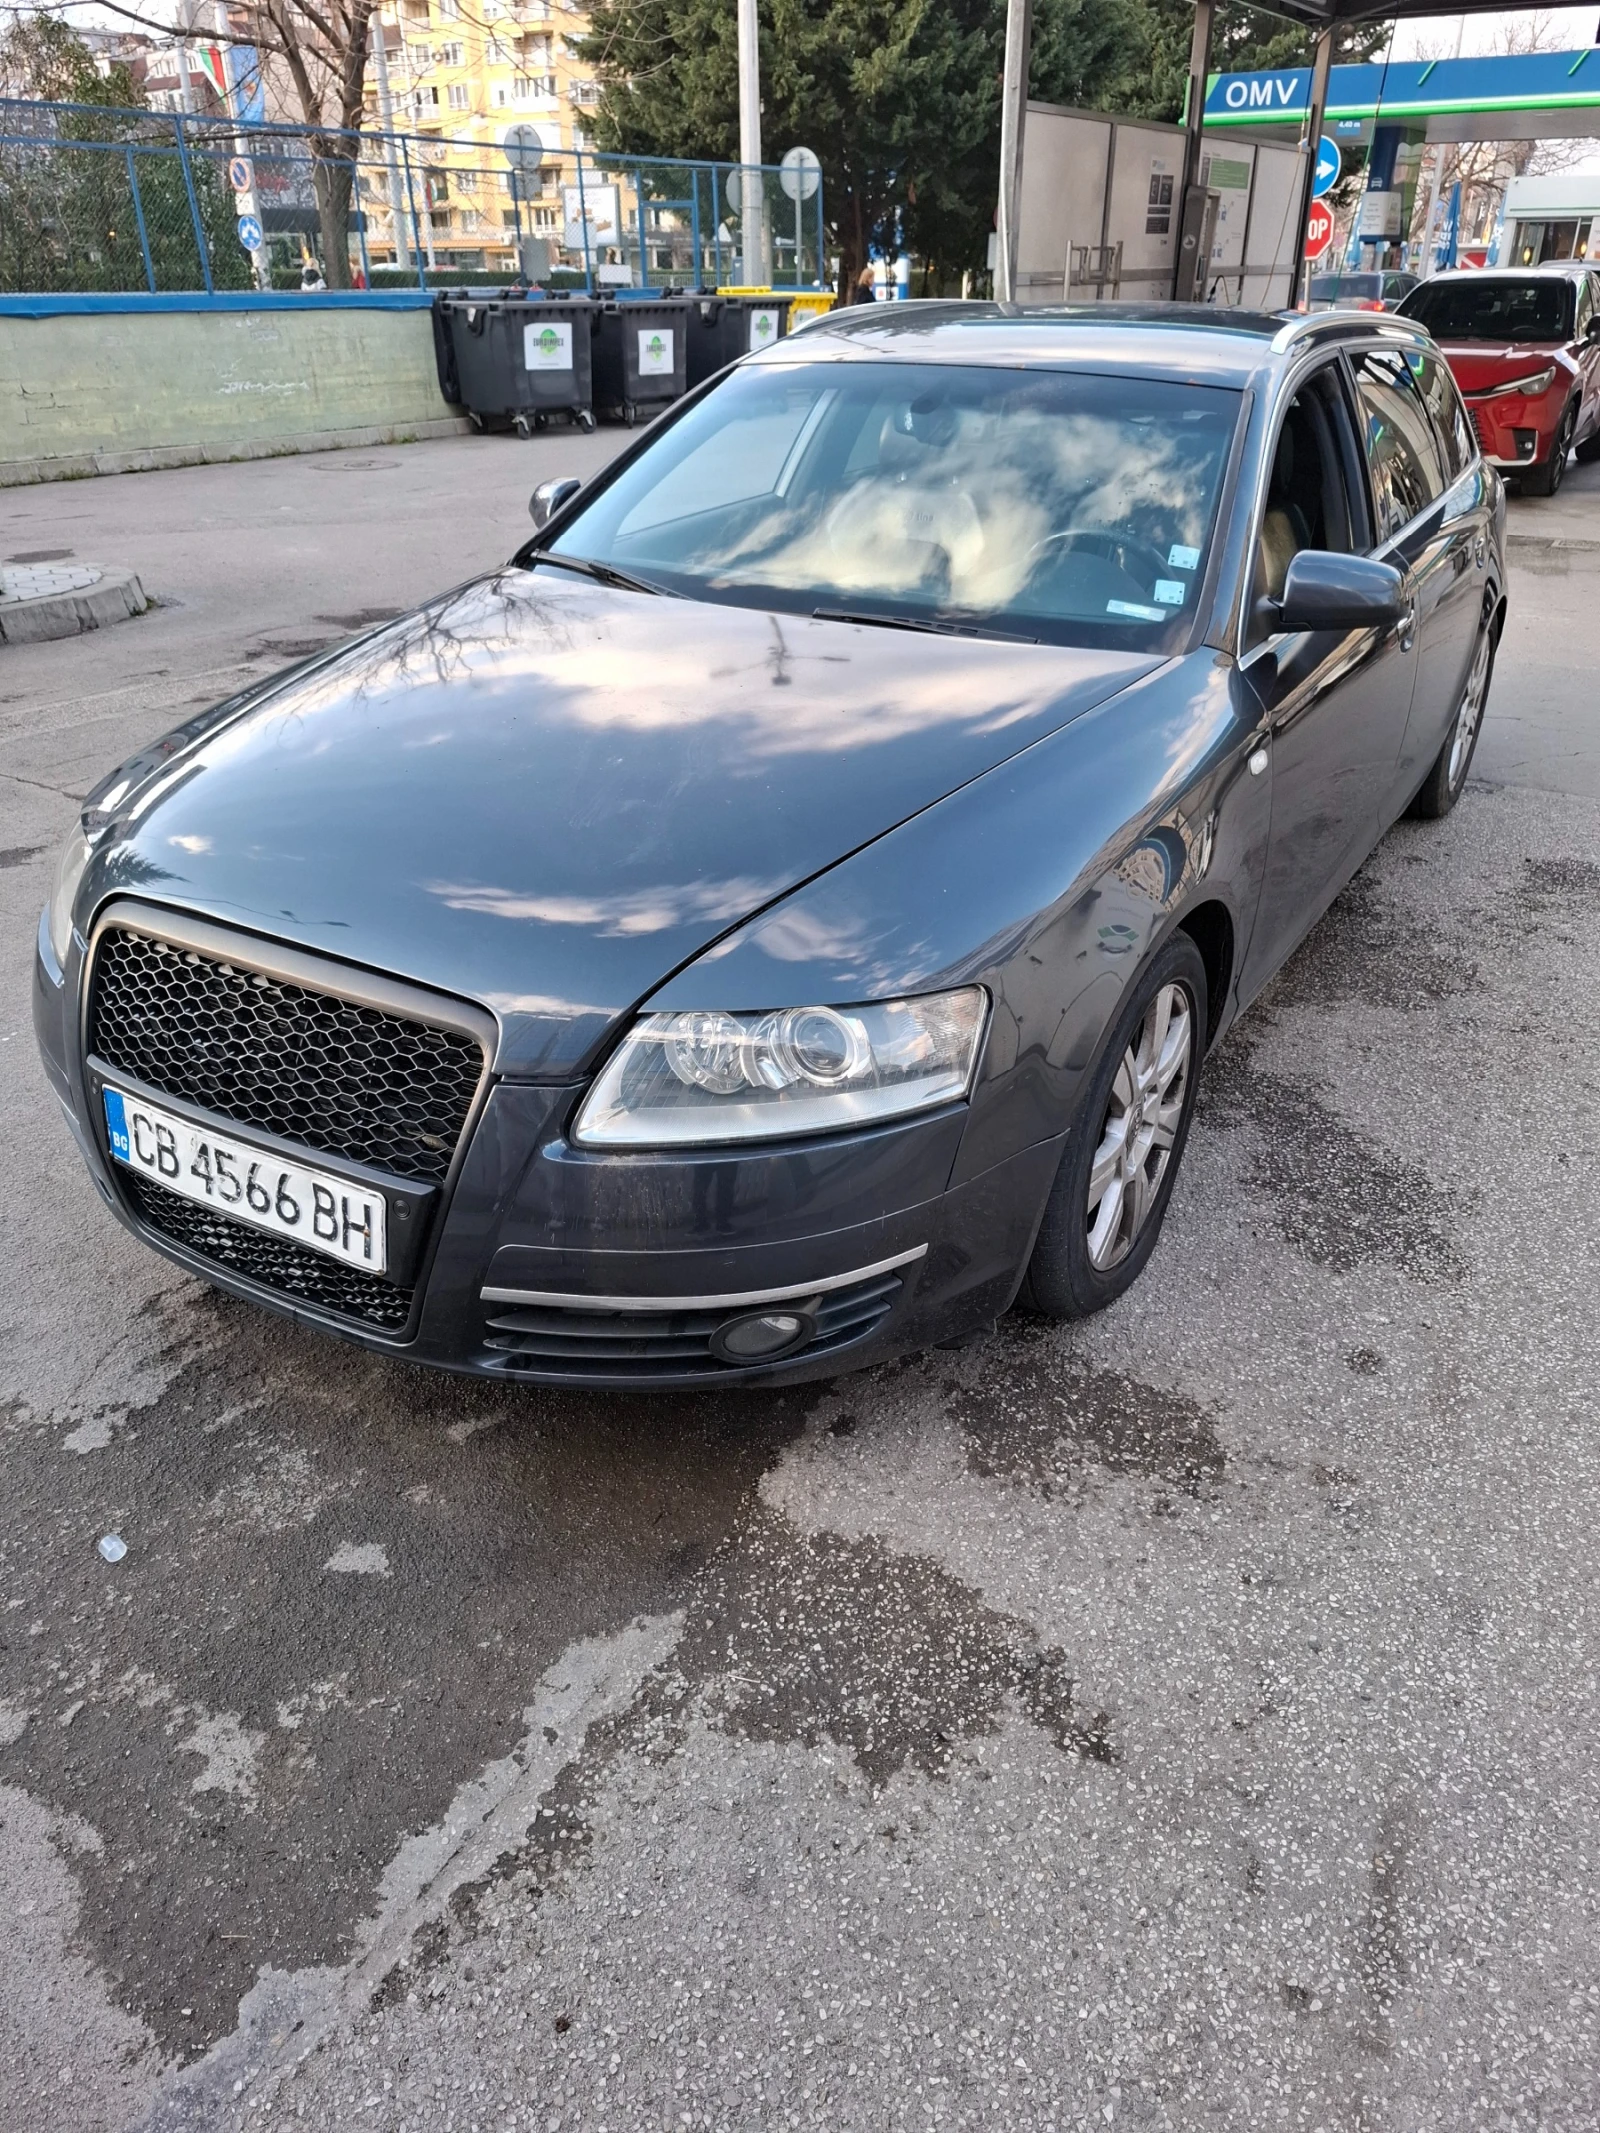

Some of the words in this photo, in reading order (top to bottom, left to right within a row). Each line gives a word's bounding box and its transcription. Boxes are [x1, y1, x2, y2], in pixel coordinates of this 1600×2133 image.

[1226, 78, 1298, 107] OMV
[1307, 218, 1329, 241] OP
[112, 1130, 128, 1152] BG
[190, 1142, 302, 1226] 4566
